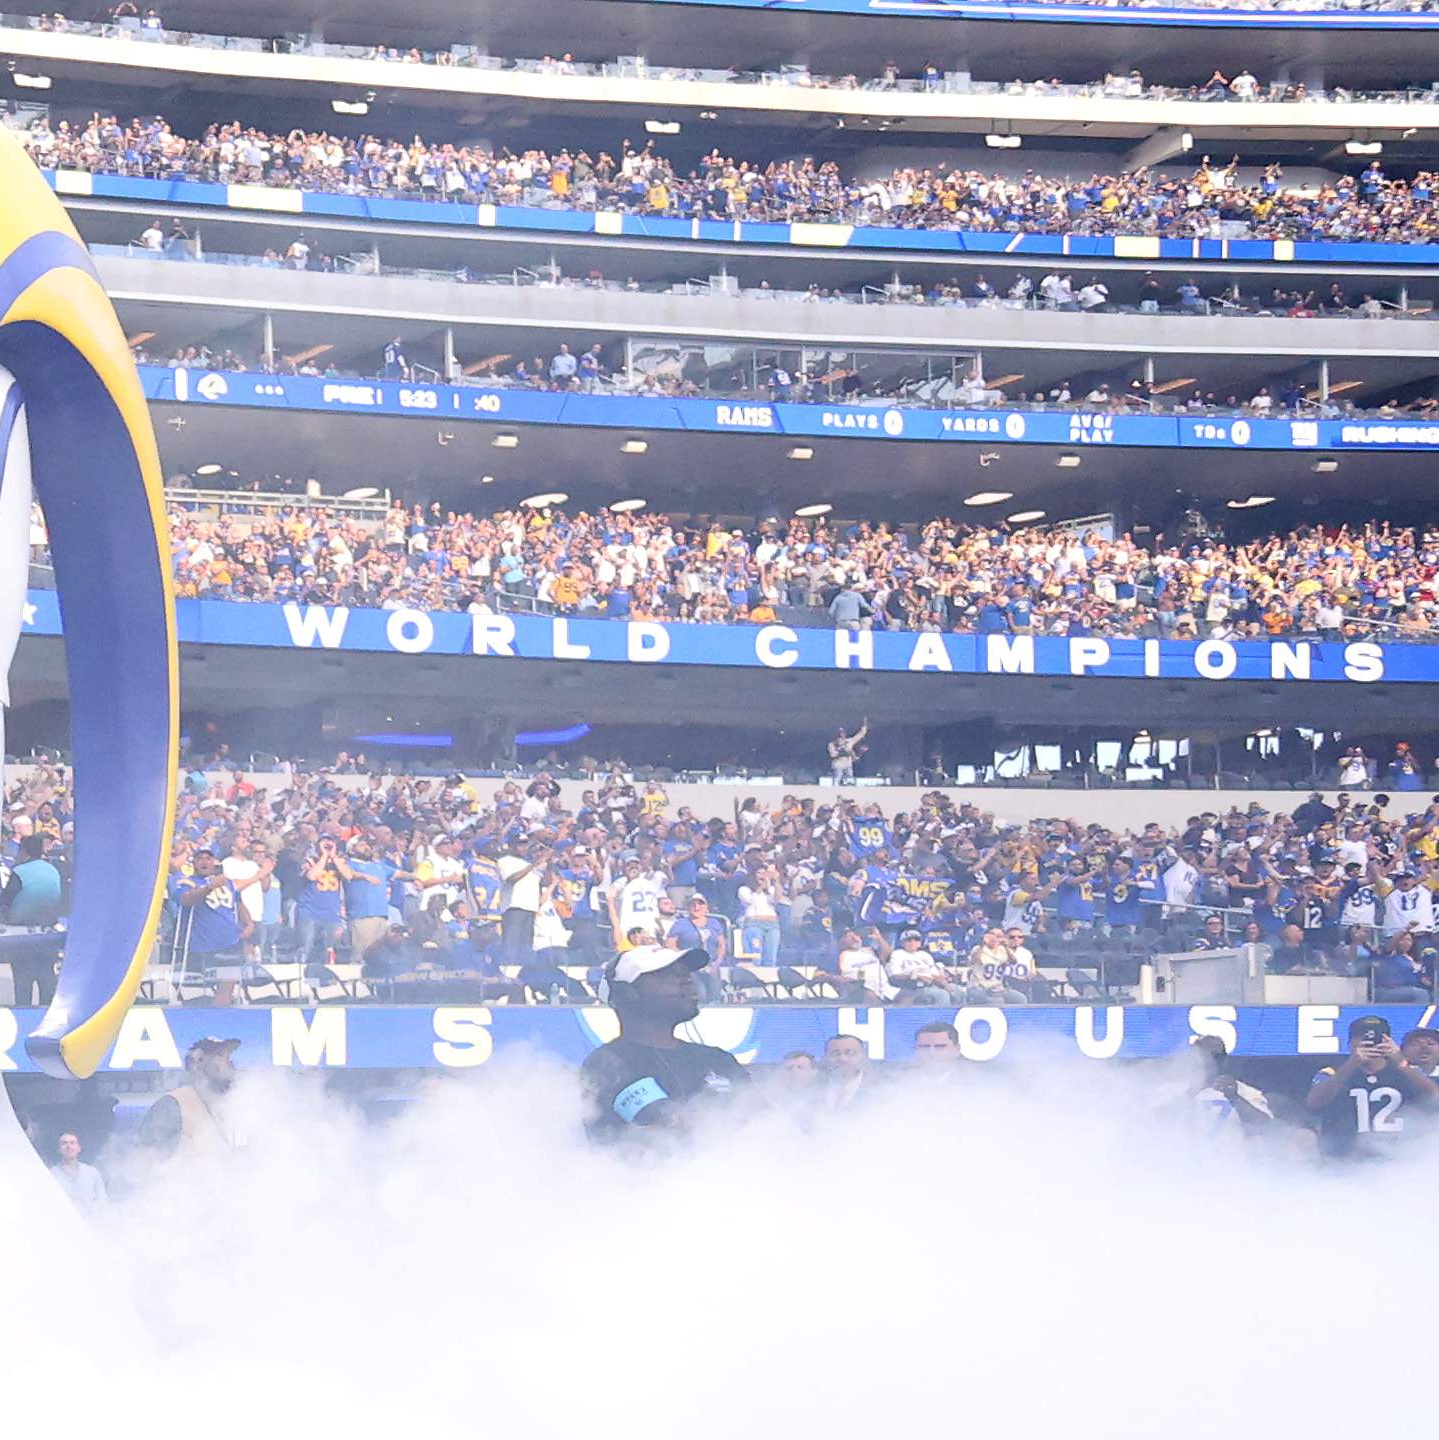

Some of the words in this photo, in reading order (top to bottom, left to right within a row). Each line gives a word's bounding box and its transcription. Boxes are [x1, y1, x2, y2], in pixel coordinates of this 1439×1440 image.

[399, 389, 437, 409] 5:23
[716, 405, 773, 428] RAMS
[822, 412, 879, 429] PLAYS
[883, 410, 903, 436] 0
[941, 416, 1000, 434] YARDS
[1005, 414, 1025, 439] 0
[1070, 428, 1114, 442] PLAY
[1230, 421, 1251, 445] 0
[283, 604, 670, 663] WORLD
[755, 625, 1384, 681] CHAMPIONS
[859, 827, 883, 847] 99
[1304, 908, 1323, 928] 12
[1350, 1087, 1404, 1132] 12
